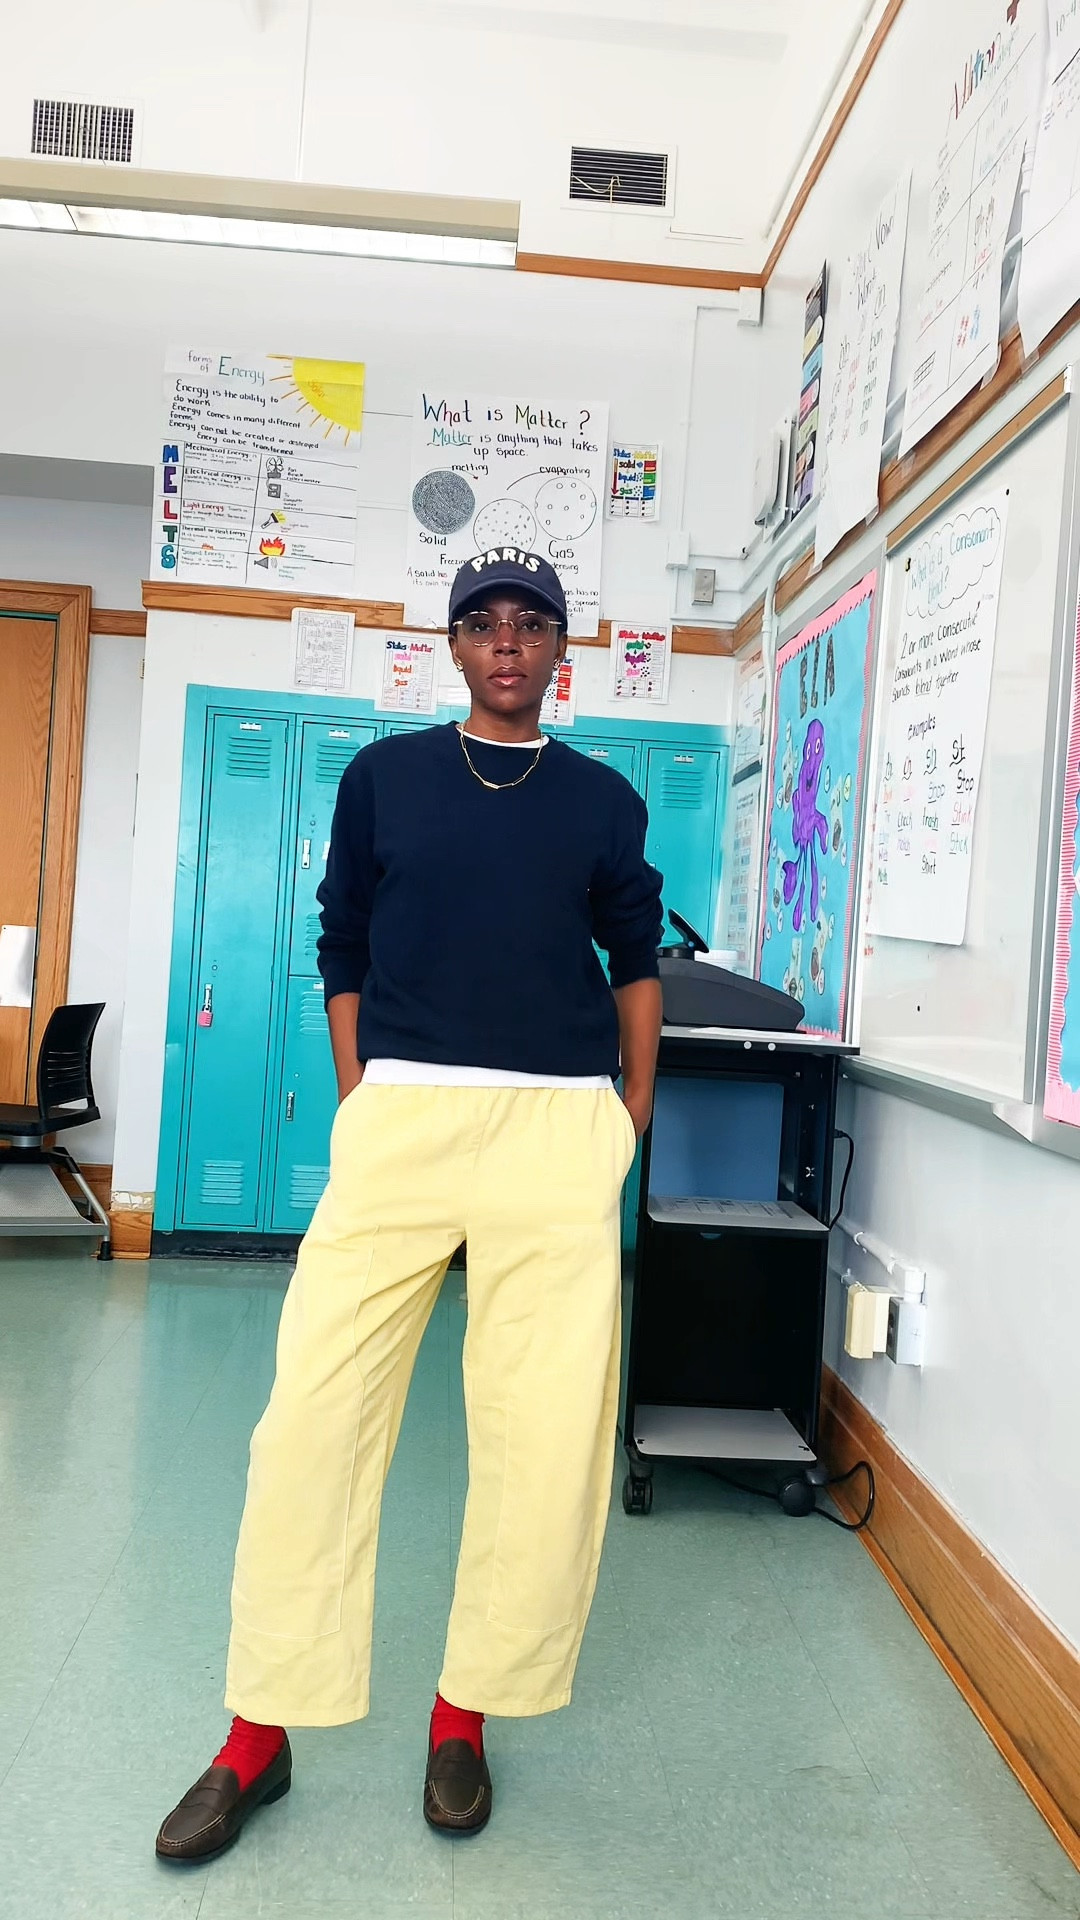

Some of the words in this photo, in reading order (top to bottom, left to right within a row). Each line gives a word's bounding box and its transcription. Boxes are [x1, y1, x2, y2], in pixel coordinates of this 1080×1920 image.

[200, 363, 209, 373] of
[218, 355, 265, 386] Energy
[173, 394, 184, 402] do
[175, 378, 209, 399] Energy
[224, 389, 238, 399] the
[239, 393, 266, 407] ability
[270, 395, 279, 403] to
[172, 402, 201, 416] Energy
[243, 416, 266, 426] many
[422, 393, 472, 427] What
[487, 406, 504, 421] is
[515, 404, 568, 430] Matter
[169, 419, 196, 431] Energy
[231, 429, 242, 437] be
[244, 431, 275, 442] created
[288, 438, 319, 449] destroyed
[238, 438, 247, 446] be
[432, 427, 474, 446] Matter
[480, 433, 492, 443] is
[543, 435, 562, 447] that
[162, 444, 179, 463] M
[473, 447, 489, 460] up
[164, 465, 178, 494] E
[451, 464, 489, 475] melting
[539, 465, 591, 478] evaporating
[619, 487, 633, 495] gas
[163, 500, 178, 519] L
[201, 502, 225, 512] Energy
[162, 524, 178, 543] T
[419, 531, 447, 546] Solid
[160, 544, 177, 570] S
[440, 553, 470, 565] Freezin
[548, 540, 575, 559] Gas
[470, 547, 542, 573] PARIS
[406, 566, 413, 578] A
[576, 587, 589, 596] has
[800, 633, 836, 721] ELA
